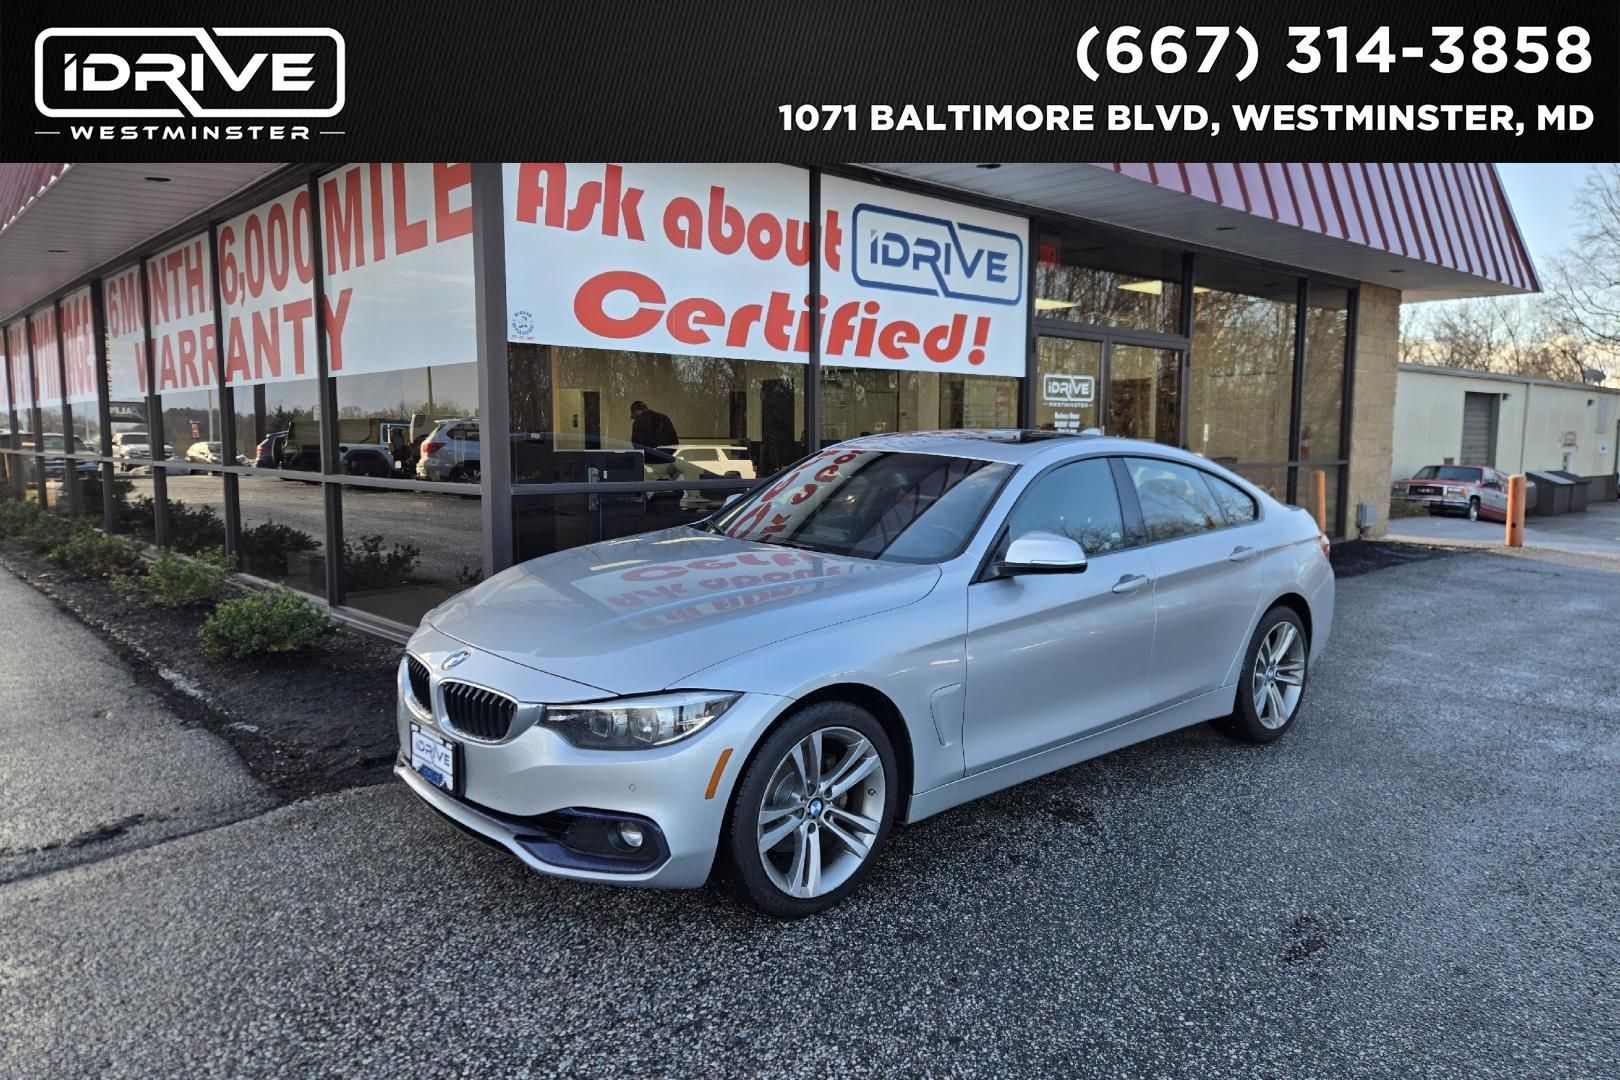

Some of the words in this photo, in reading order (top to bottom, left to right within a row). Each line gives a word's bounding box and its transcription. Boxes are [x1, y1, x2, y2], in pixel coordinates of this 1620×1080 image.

[516, 163, 646, 241] Ask
[662, 185, 843, 272] about
[134, 288, 354, 394] WARRANTY
[573, 270, 992, 366] Certified!
